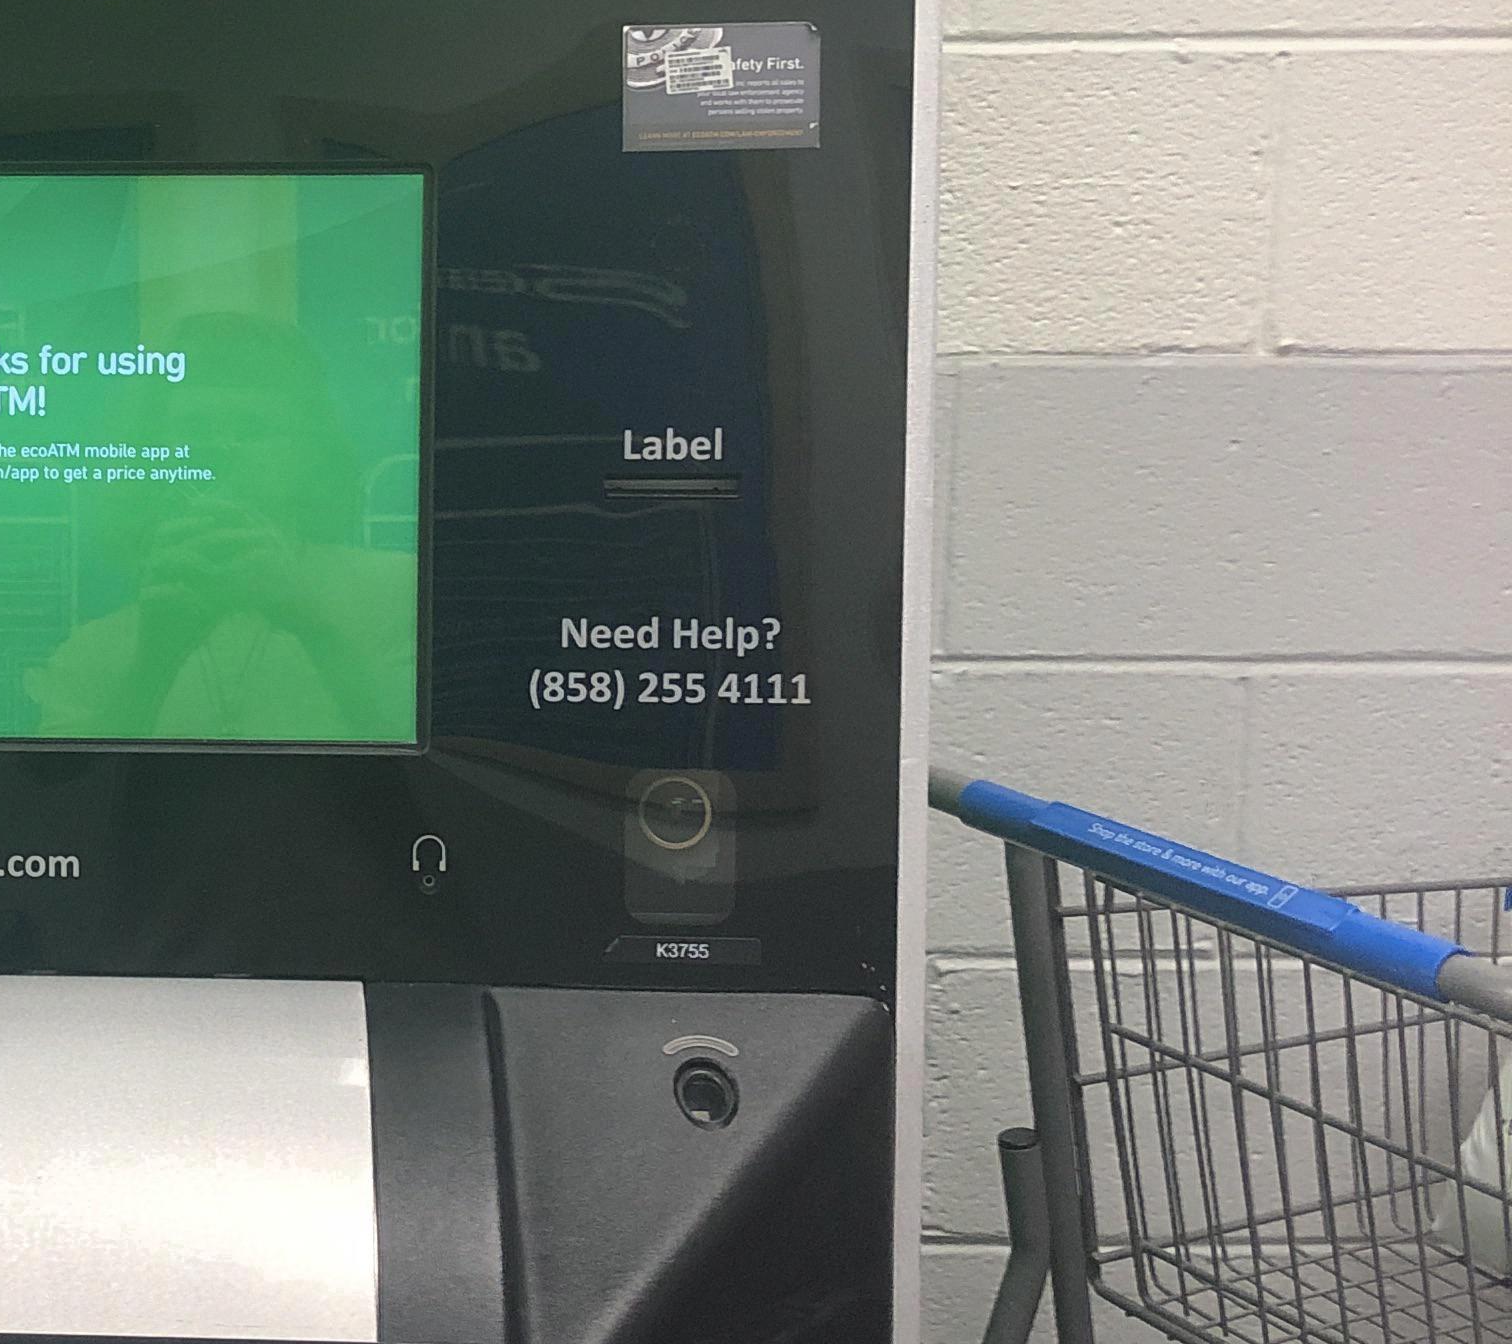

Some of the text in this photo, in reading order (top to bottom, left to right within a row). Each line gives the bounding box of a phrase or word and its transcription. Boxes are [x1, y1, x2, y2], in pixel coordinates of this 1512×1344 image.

[730, 57, 804, 73] afety First.
[39, 344, 88, 375] for
[97, 344, 186, 382] using
[21, 443, 80, 458] ecoATM
[85, 443, 136, 458] mobile
[141, 446, 170, 462] app
[175, 445, 190, 458] at
[624, 428, 723, 461] Label
[44, 466, 59, 479] to
[64, 466, 88, 483] get
[93, 469, 102, 480] a
[107, 465, 145, 484] price
[150, 466, 216, 484] anytime.
[561, 616, 781, 658] Need Help?
[529, 669, 810, 710] (858) 255 4111
[656, 943, 710, 959] K3755
